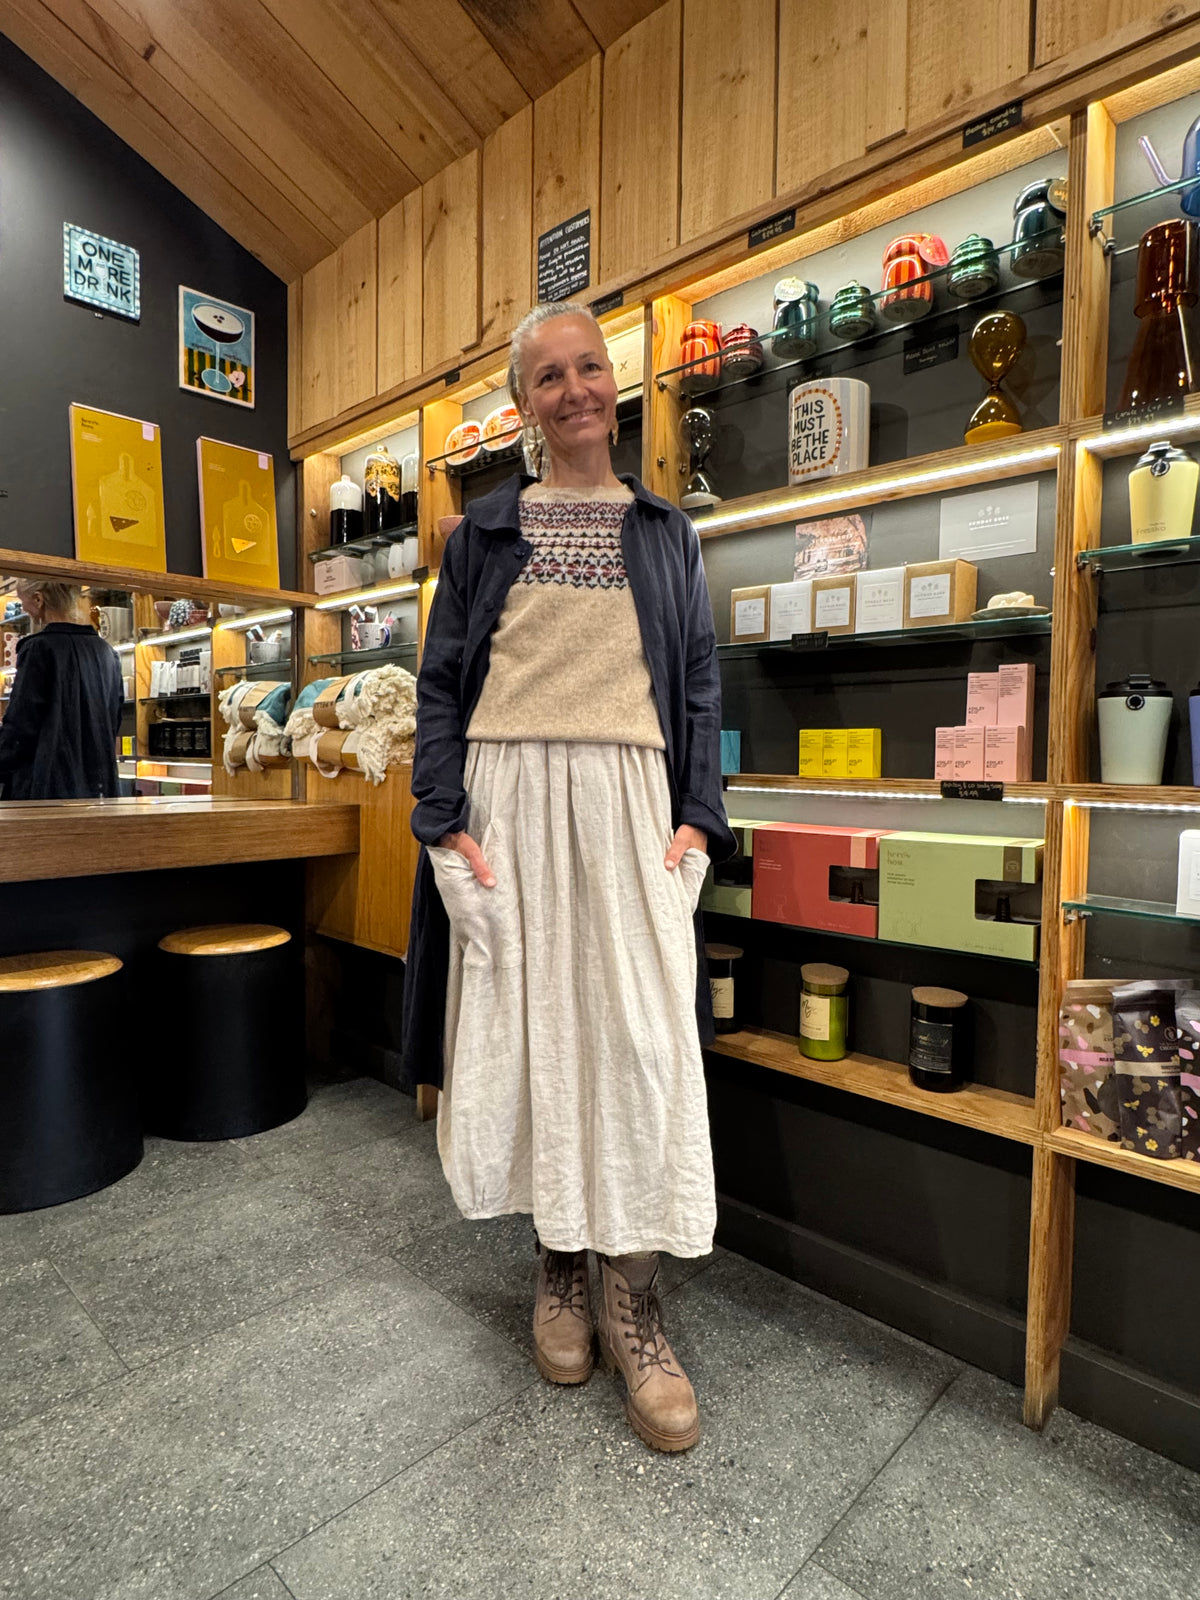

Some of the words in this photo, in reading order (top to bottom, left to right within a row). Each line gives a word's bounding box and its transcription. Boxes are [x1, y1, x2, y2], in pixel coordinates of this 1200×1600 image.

[83, 242, 125, 269] ONE
[795, 400, 824, 420] THIS
[794, 415, 826, 436] MUST
[792, 446, 826, 467] PLACE
